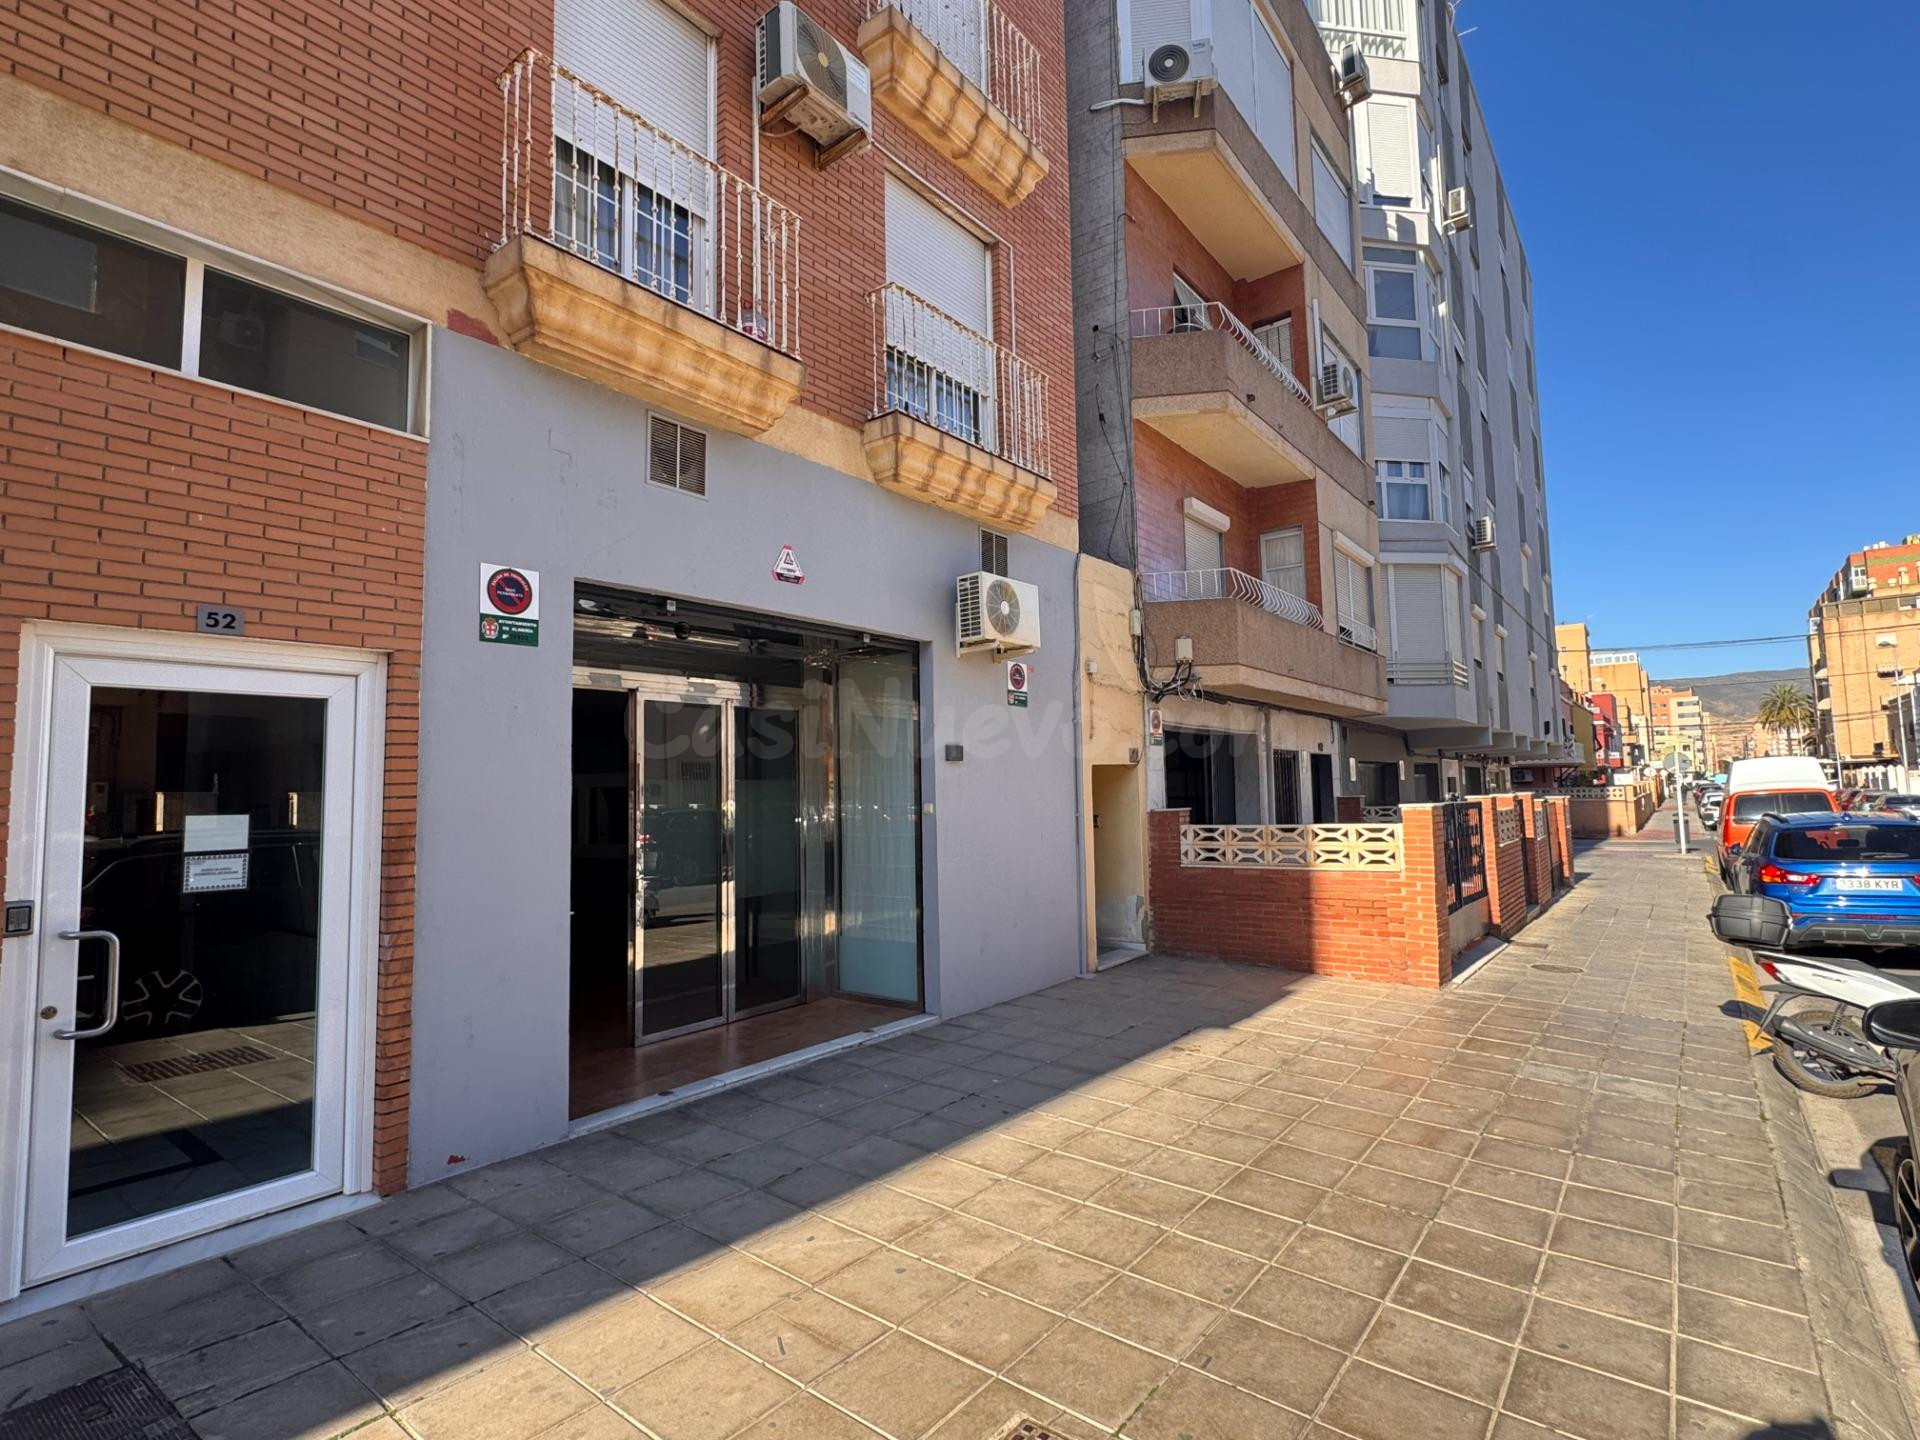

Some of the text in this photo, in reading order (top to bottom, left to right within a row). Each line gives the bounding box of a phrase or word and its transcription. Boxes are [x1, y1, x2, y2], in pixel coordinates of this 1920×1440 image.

[205, 611, 236, 629] 52
[498, 619, 537, 628] AYUNTAMIENTO
[1874, 879, 1900, 889] KYR
